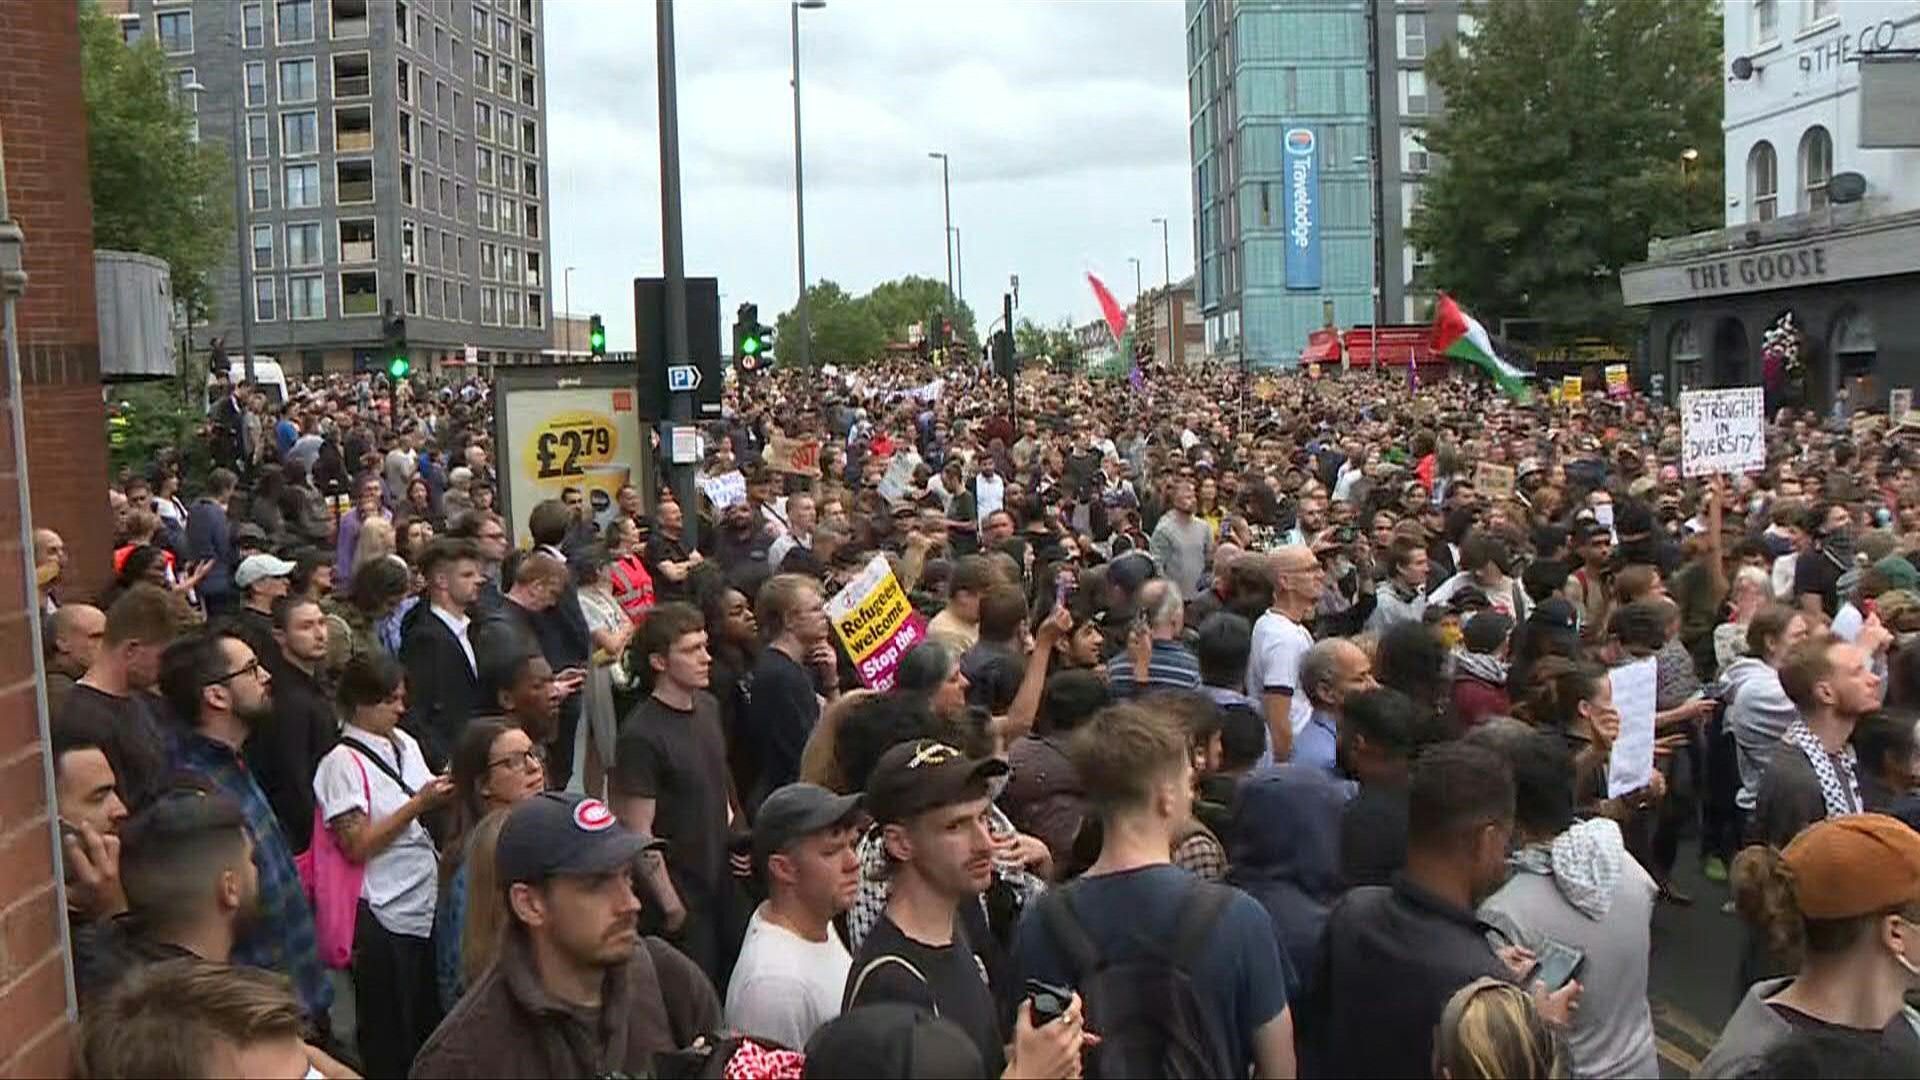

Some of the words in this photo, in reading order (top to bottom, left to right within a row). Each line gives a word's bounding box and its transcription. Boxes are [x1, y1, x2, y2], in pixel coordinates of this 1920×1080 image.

[1815, 35, 1850, 72] THE
[1292, 155, 1312, 247] Travelodge
[1687, 263, 1729, 289] THE
[1740, 248, 1825, 284] GOOSE
[674, 371, 685, 386] P
[1693, 399, 1755, 422] STRENGTH
[1716, 422, 1729, 436] IN
[537, 427, 610, 478] £2.79
[1690, 433, 1756, 460] DIVERSITY
[840, 583, 897, 638] Refugees
[850, 601, 904, 654] welcome
[863, 646, 898, 679] Stop
[895, 624, 917, 652] the
